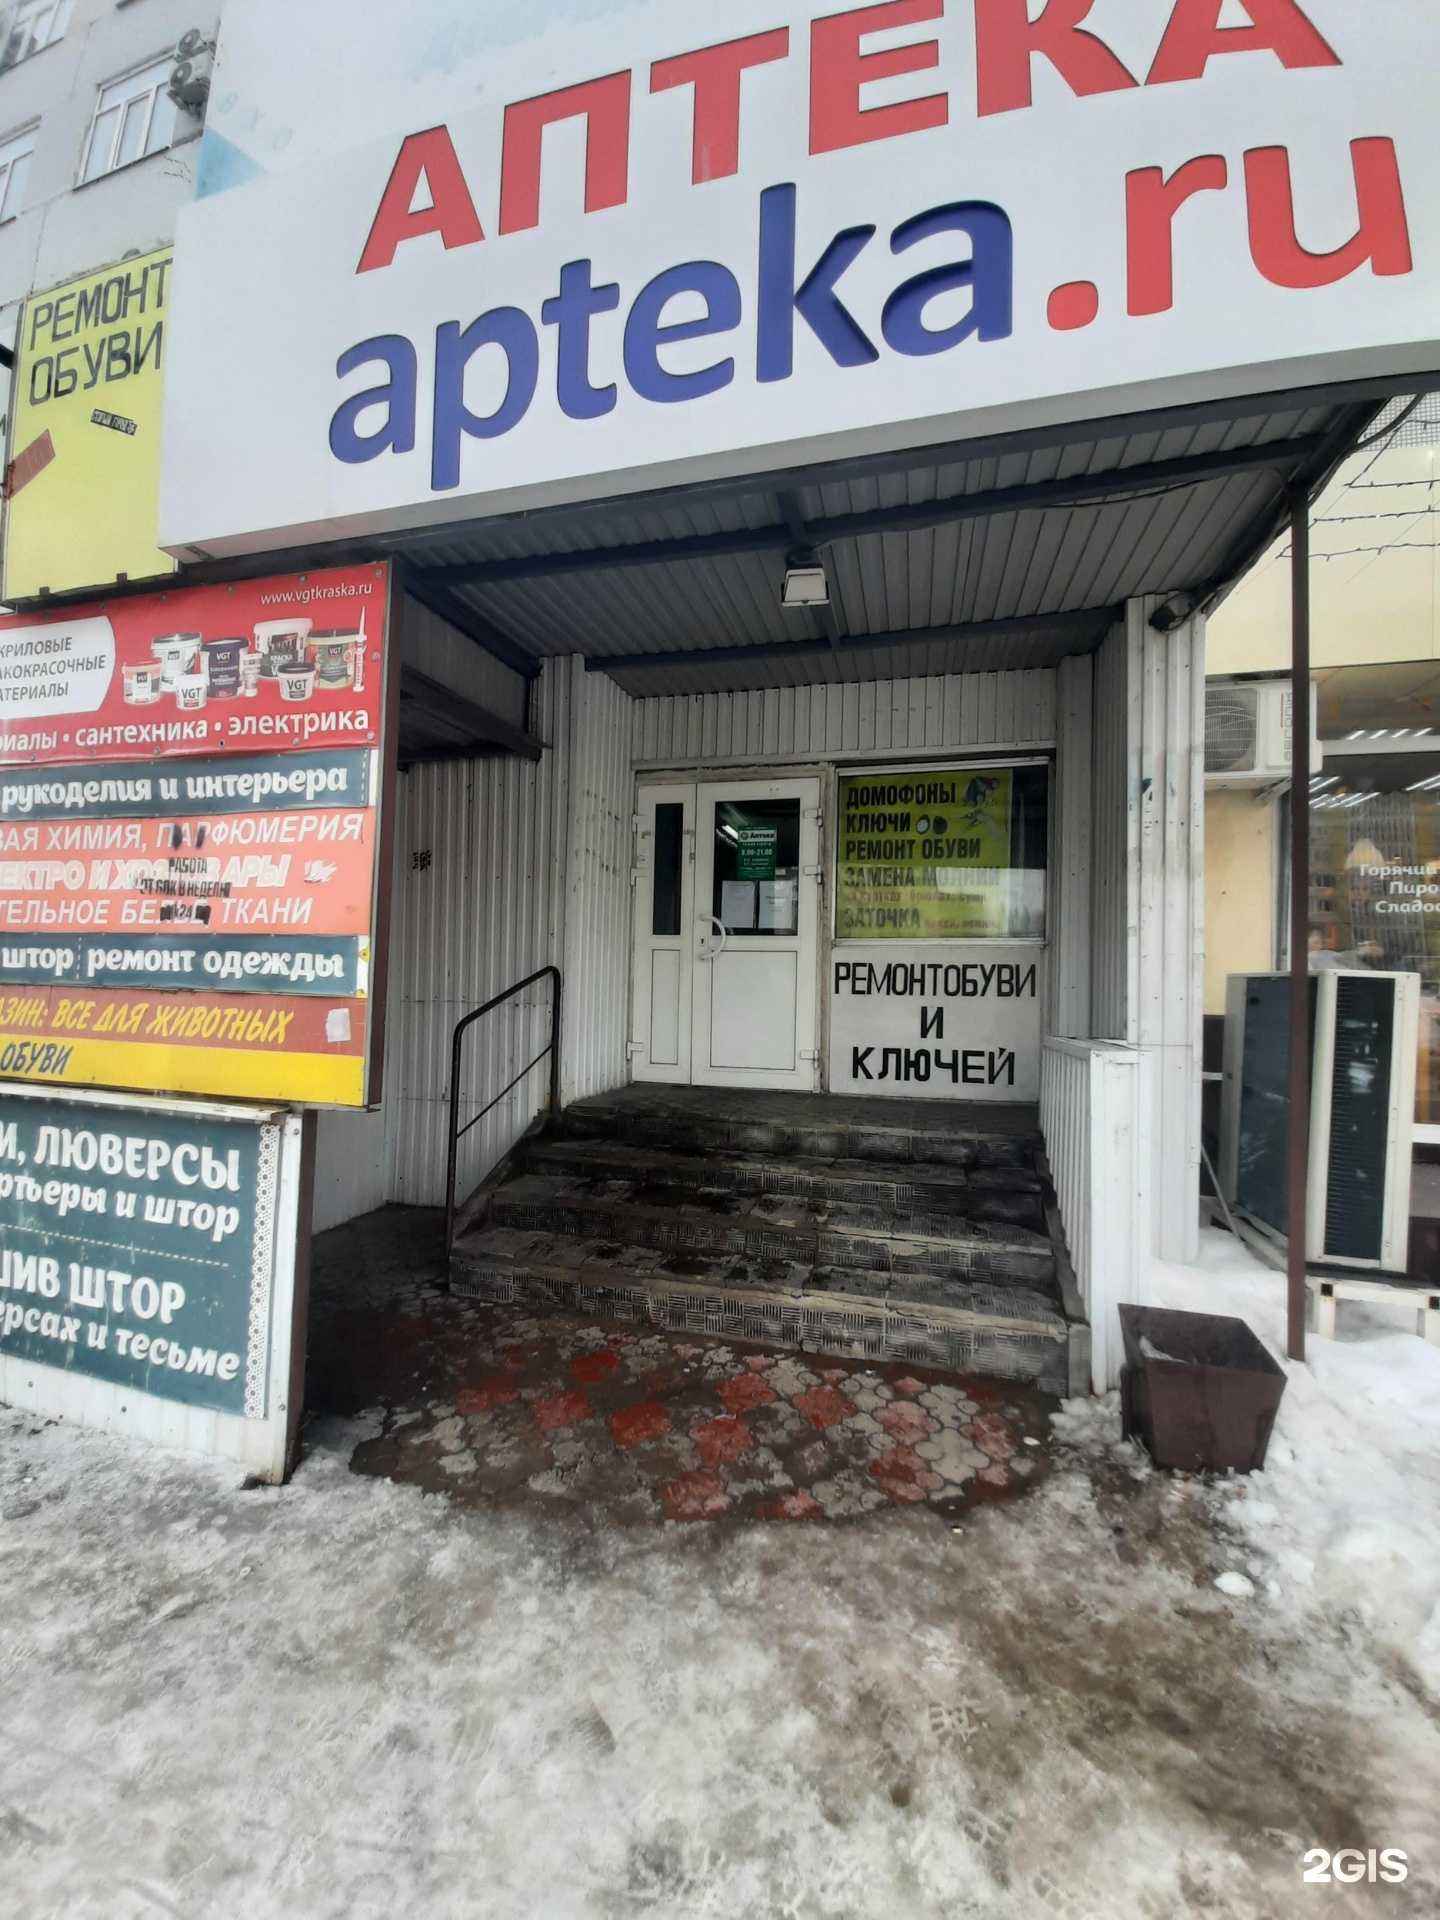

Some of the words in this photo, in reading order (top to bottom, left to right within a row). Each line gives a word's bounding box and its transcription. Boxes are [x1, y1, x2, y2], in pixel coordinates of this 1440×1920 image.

[356, 0, 1343, 274] АПТЕКА
[30, 257, 173, 351] РЕМОНТ
[328, 136, 1414, 491] apteka.ru
[29, 320, 163, 406] ОБУВИ
[261, 582, 373, 605] www.vgtkraska.ru
[181, 687, 202, 700] VGT
[287, 678, 308, 691] VGT
[75, 717, 208, 748] сантехника
[228, 709, 369, 740] электрика
[2, 777, 152, 813] рукоделия
[159, 776, 177, 797] и
[186, 767, 348, 803] интерьера
[847, 782, 957, 810] ДОМОФОНЫ
[46, 824, 147, 853] ХИМИЯ,
[846, 812, 911, 833] КЛЮЧИ
[845, 839, 916, 860] РЕМОНТ
[922, 838, 981, 859] ОБУВИ
[843, 866, 915, 887] ЗАМЕНА
[223, 897, 313, 925] ТКАНИ
[844, 907, 920, 928] ЗАТОЧКА
[2, 947, 73, 977] штор
[87, 948, 197, 977] ремонт
[203, 951, 344, 982] одежды
[52, 999, 97, 1030] ВСЕ
[92, 1003, 149, 1034] ДЛЯ
[146, 1004, 294, 1044] ЖИВОТНЫХ
[920, 1006, 944, 1039] И
[0, 1041, 74, 1076] ОБУВИ
[852, 1047, 1015, 1086] КЛЮЧЕЙ
[33, 1125, 241, 1192] ЛЮВЕРСЫ
[115, 1191, 136, 1218] и
[143, 1194, 240, 1243] штор
[69, 1262, 186, 1324] ШТОР
[0, 1300, 82, 1342] рсах
[88, 1321, 108, 1350] и
[115, 1328, 241, 1380] тесьме
